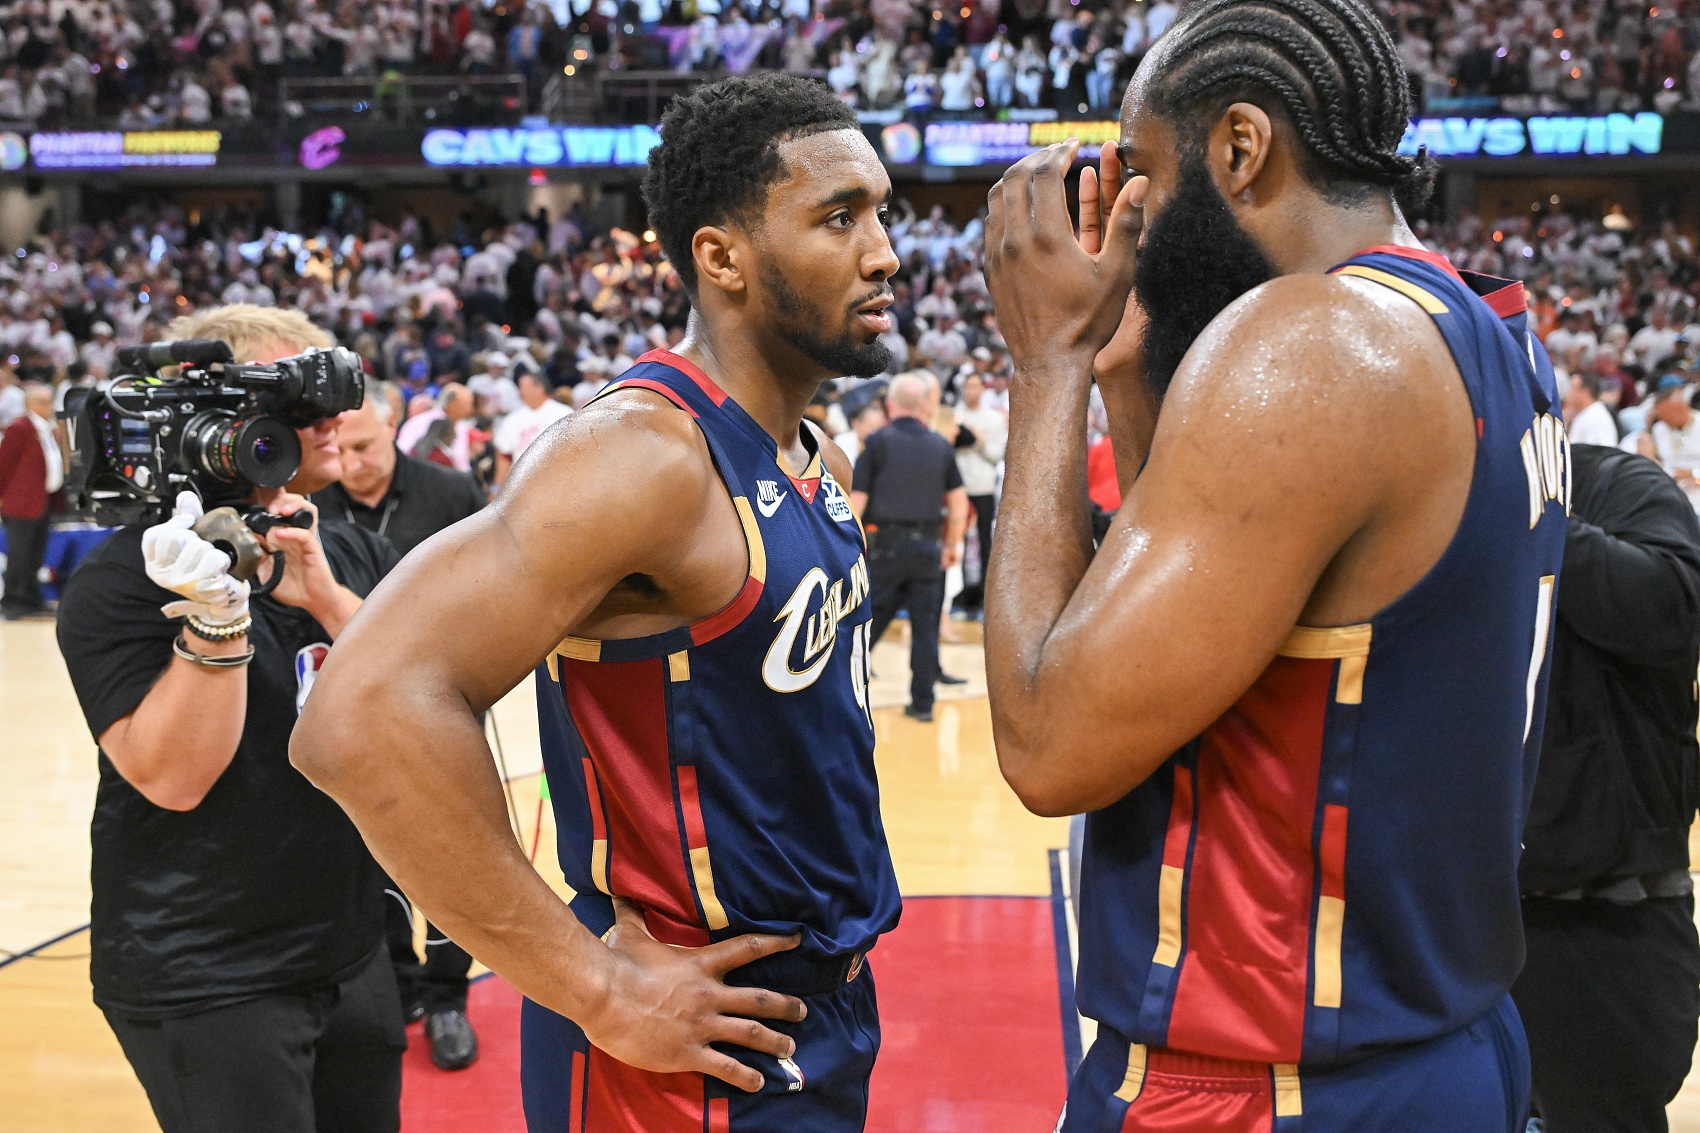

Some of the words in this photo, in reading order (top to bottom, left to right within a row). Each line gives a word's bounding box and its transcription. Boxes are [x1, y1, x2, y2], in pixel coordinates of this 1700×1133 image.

[421, 128, 563, 165] CAVS
[1527, 112, 1664, 155] WIN
[756, 479, 779, 502] NIKE
